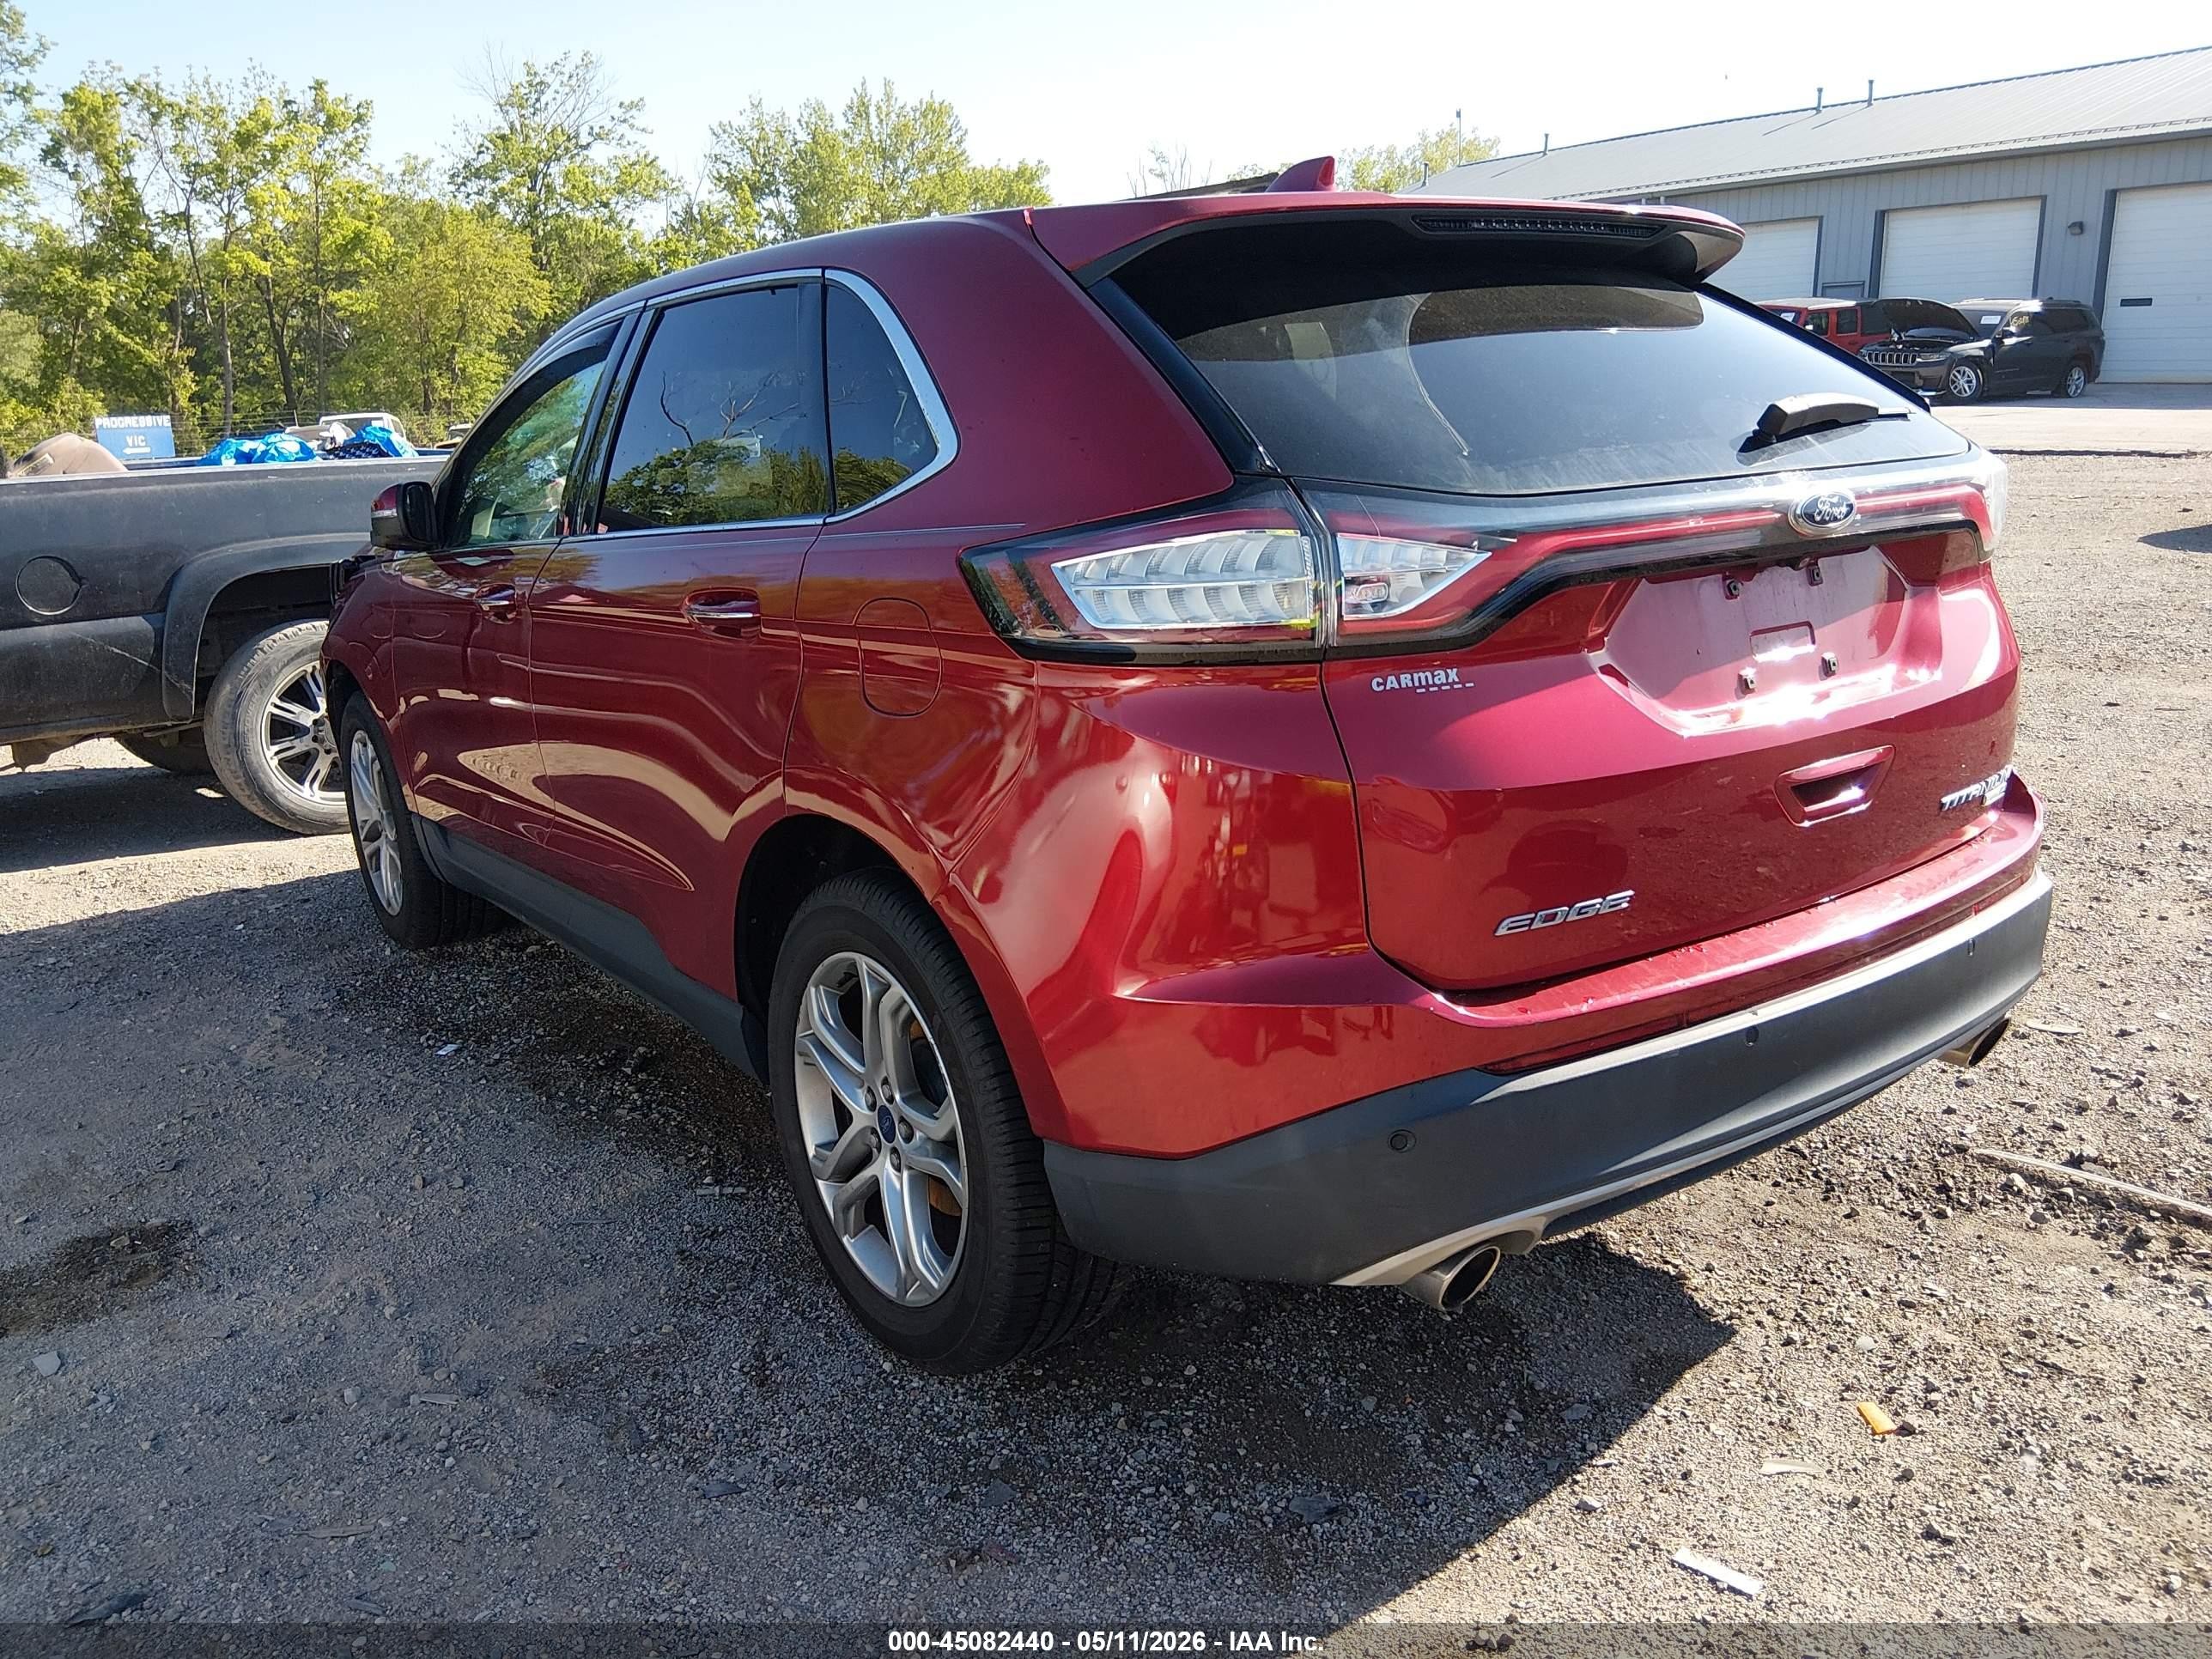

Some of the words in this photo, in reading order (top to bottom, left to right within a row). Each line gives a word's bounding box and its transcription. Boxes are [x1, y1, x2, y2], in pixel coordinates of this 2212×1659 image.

[94, 415, 171, 428] PROGRESSIVE
[125, 434, 146, 447] VIC
[1814, 495, 1850, 522] Ford
[1493, 890, 1635, 937] EDGE
